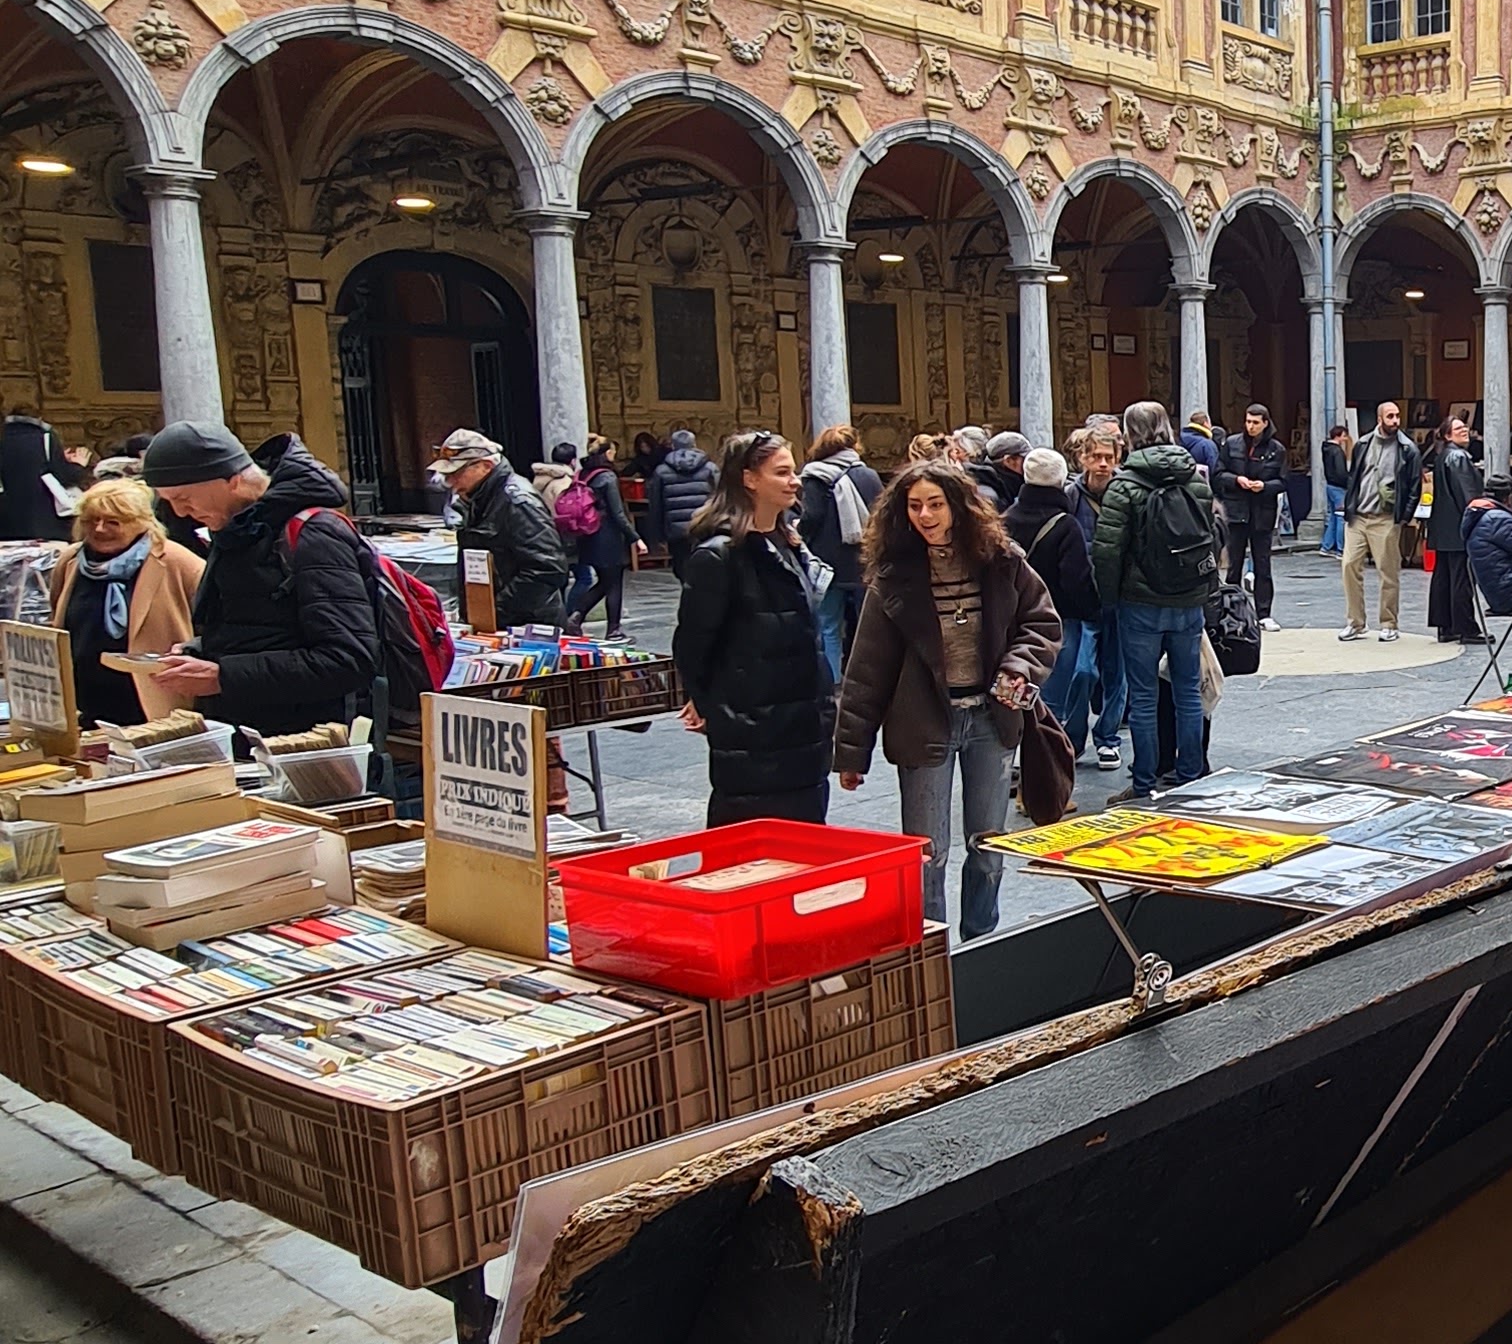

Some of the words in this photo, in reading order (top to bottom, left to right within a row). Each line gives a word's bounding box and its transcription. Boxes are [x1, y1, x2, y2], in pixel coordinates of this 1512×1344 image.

[441, 712, 528, 777] LIVRES
[440, 780, 471, 802] PRIX
[473, 786, 530, 812] INDIQUÉ
[474, 814, 495, 827] page
[508, 818, 528, 833] livre
